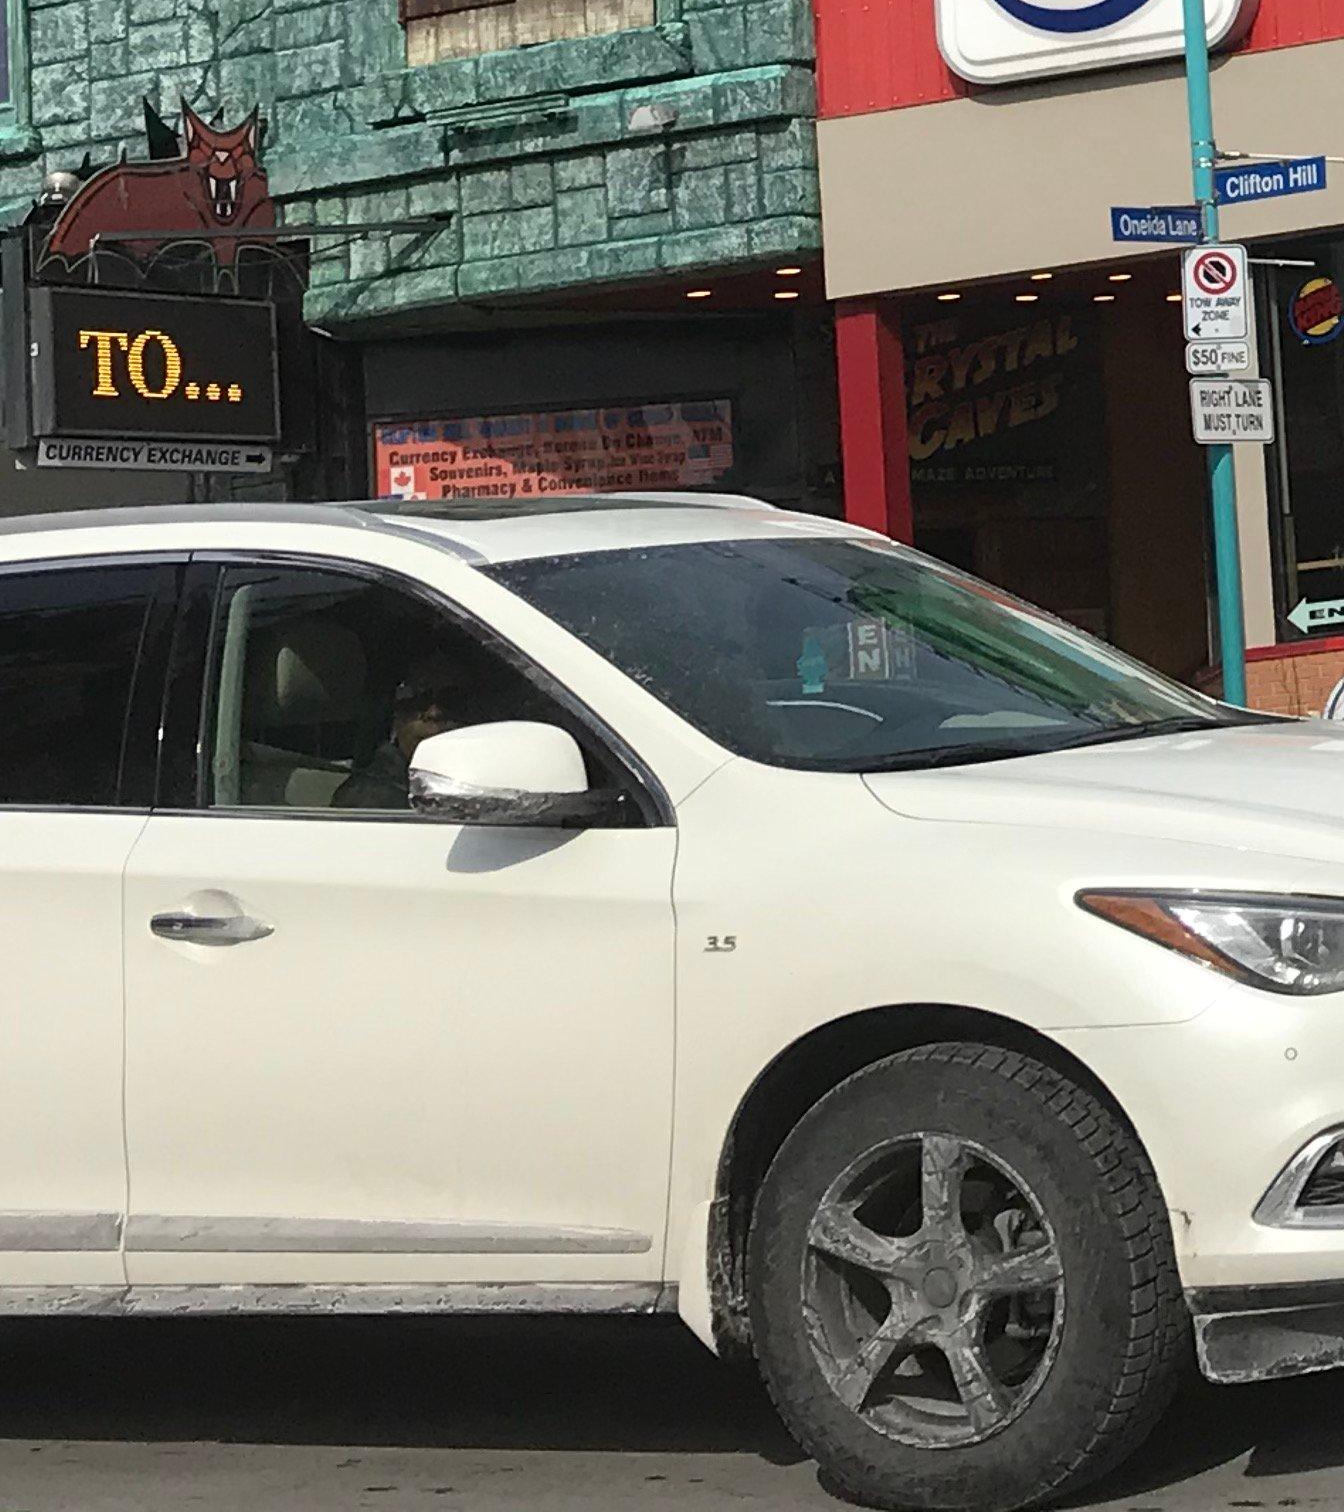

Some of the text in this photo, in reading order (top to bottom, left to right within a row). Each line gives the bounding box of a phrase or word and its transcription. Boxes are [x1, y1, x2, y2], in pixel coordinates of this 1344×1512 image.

[1226, 163, 1318, 199] Clifton Hill
[1119, 214, 1198, 236] Oneida Lane
[1189, 296, 1241, 308] TOW AWAY
[1202, 310, 1230, 321] ZONE
[79, 330, 242, 401] TO...
[909, 316, 1079, 405] RYSTAL
[1192, 349, 1246, 366] $50 FINE
[1200, 389, 1263, 408] RIGHT LANE
[1203, 413, 1264, 431] MUST TURN
[45, 444, 240, 467] CURRENCY EXCHANGE
[389, 447, 457, 466] Currency
[429, 462, 508, 481] Souvenirs,
[442, 479, 517, 499] Pharmacy
[521, 478, 533, 492] &
